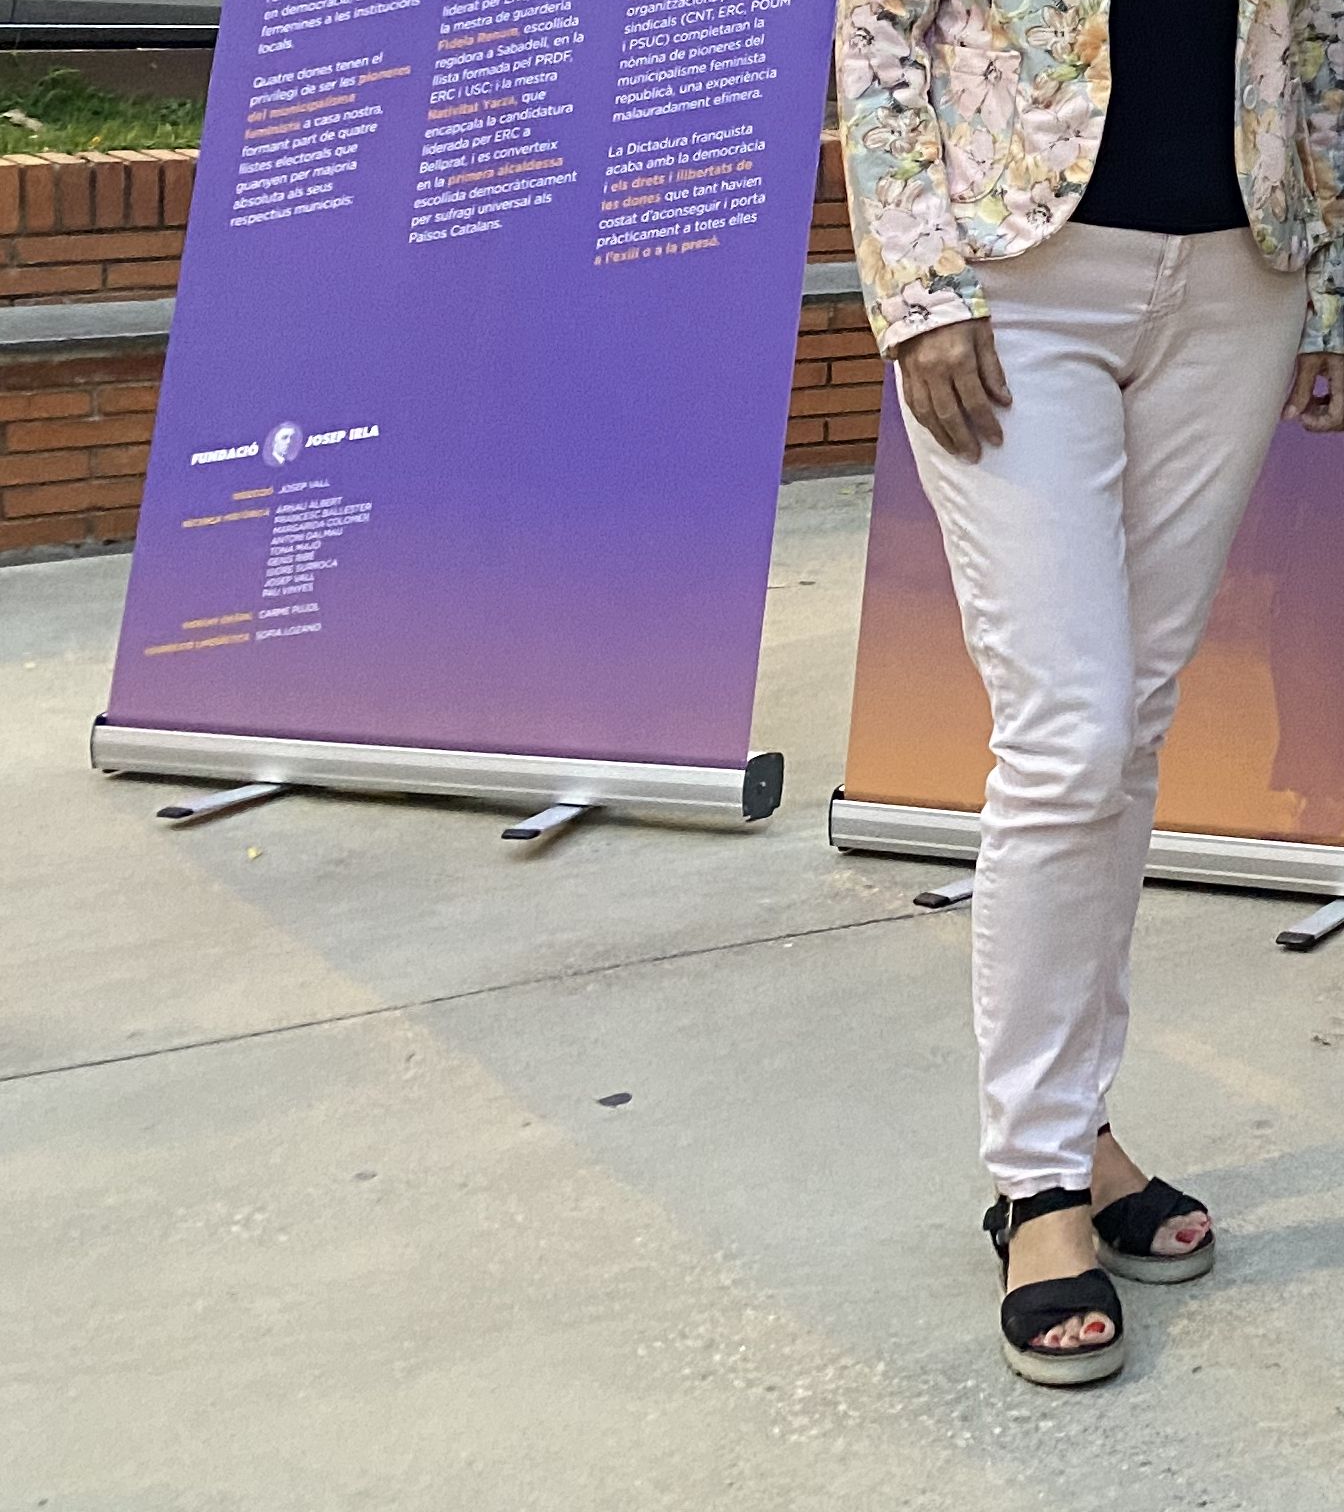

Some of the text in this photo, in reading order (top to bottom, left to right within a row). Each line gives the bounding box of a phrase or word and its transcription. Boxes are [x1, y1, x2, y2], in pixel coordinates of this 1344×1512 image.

[624, 16, 676, 34] sindicals
[608, 124, 752, 157] La Dictadura franquista
[190, 424, 380, 465] FUNDACIÓ JOSEP IRLA
